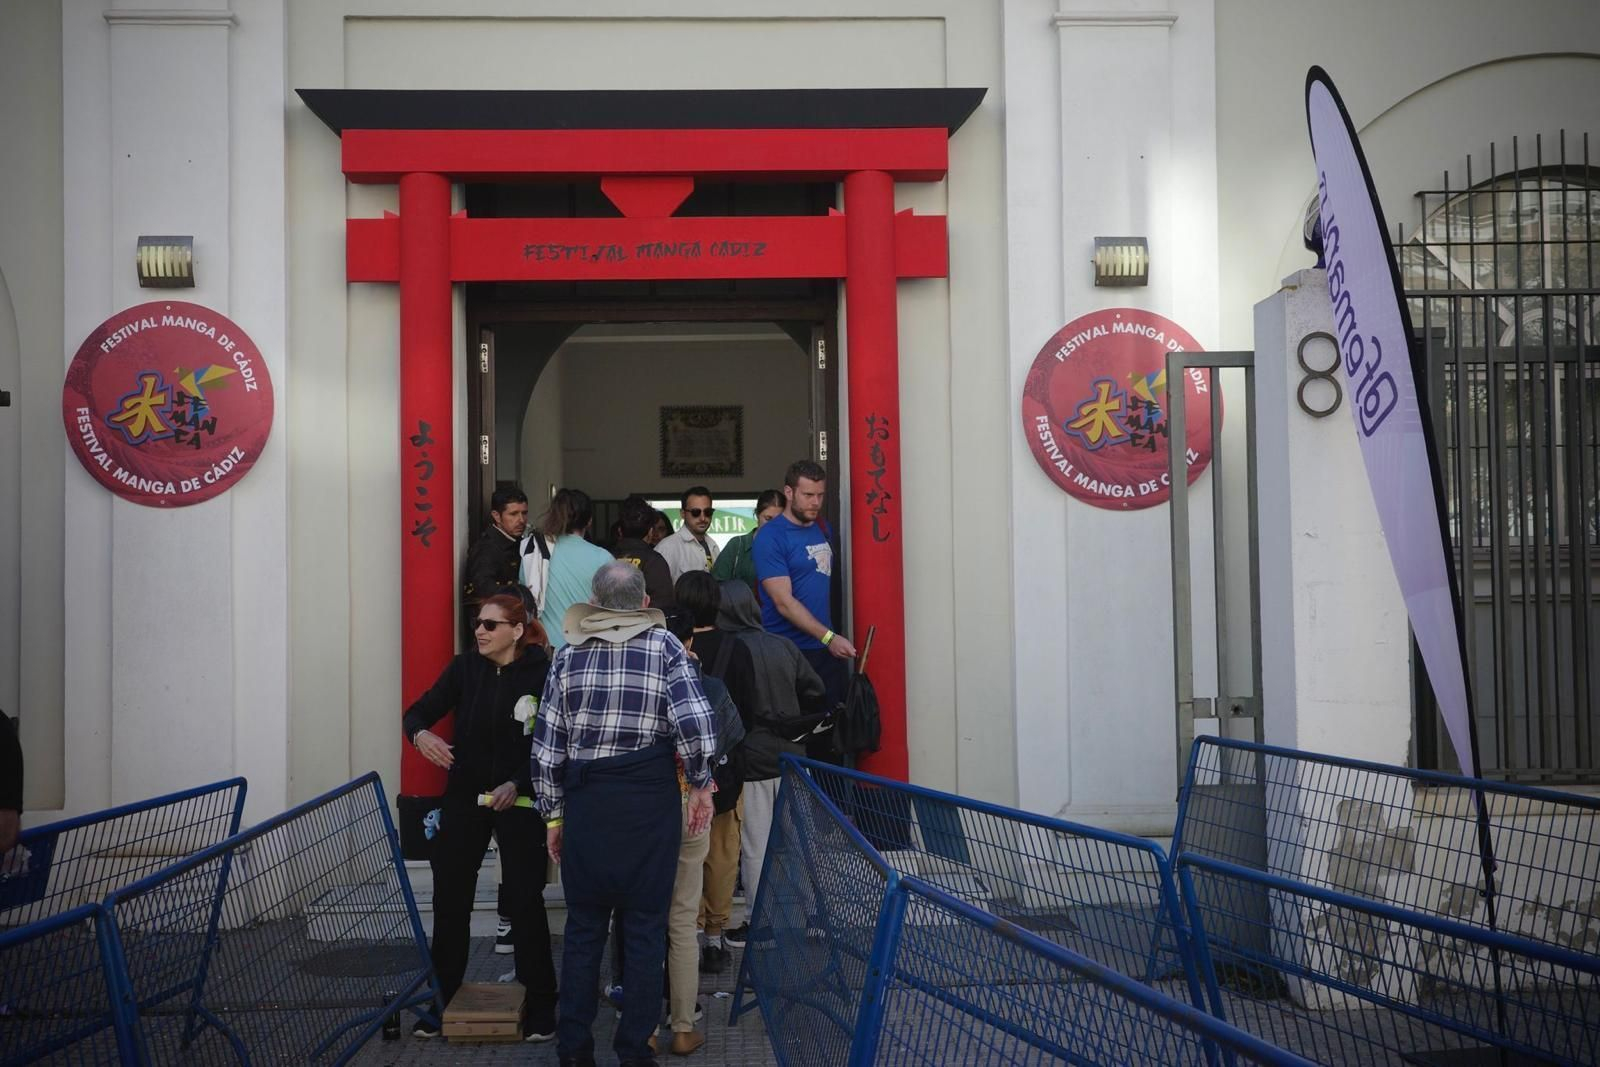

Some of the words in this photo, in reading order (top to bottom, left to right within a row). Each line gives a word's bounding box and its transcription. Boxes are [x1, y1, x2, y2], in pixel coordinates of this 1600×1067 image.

[634, 241, 702, 259] MANGA
[100, 316, 158, 354] FESTIVAL
[162, 315, 216, 339] MANGA
[217, 334, 236, 352] DE
[232, 351, 258, 393] CÁDIZ
[1055, 324, 1109, 362] FESTIVAL
[1112, 322, 1165, 344] MANGA
[1297, 332, 1343, 418] 8
[76, 407, 115, 472] FESTIVAL
[112, 466, 176, 495] MANGA
[180, 479, 201, 494] DE
[204, 446, 246, 484] CÁDIZ
[410, 420, 437, 547] ようこそ
[865, 413, 891, 542] おもてなし
[1035, 415, 1072, 478] FESTIVAL
[1073, 471, 1135, 498] MANGA
[1139, 479, 1159, 496] DE
